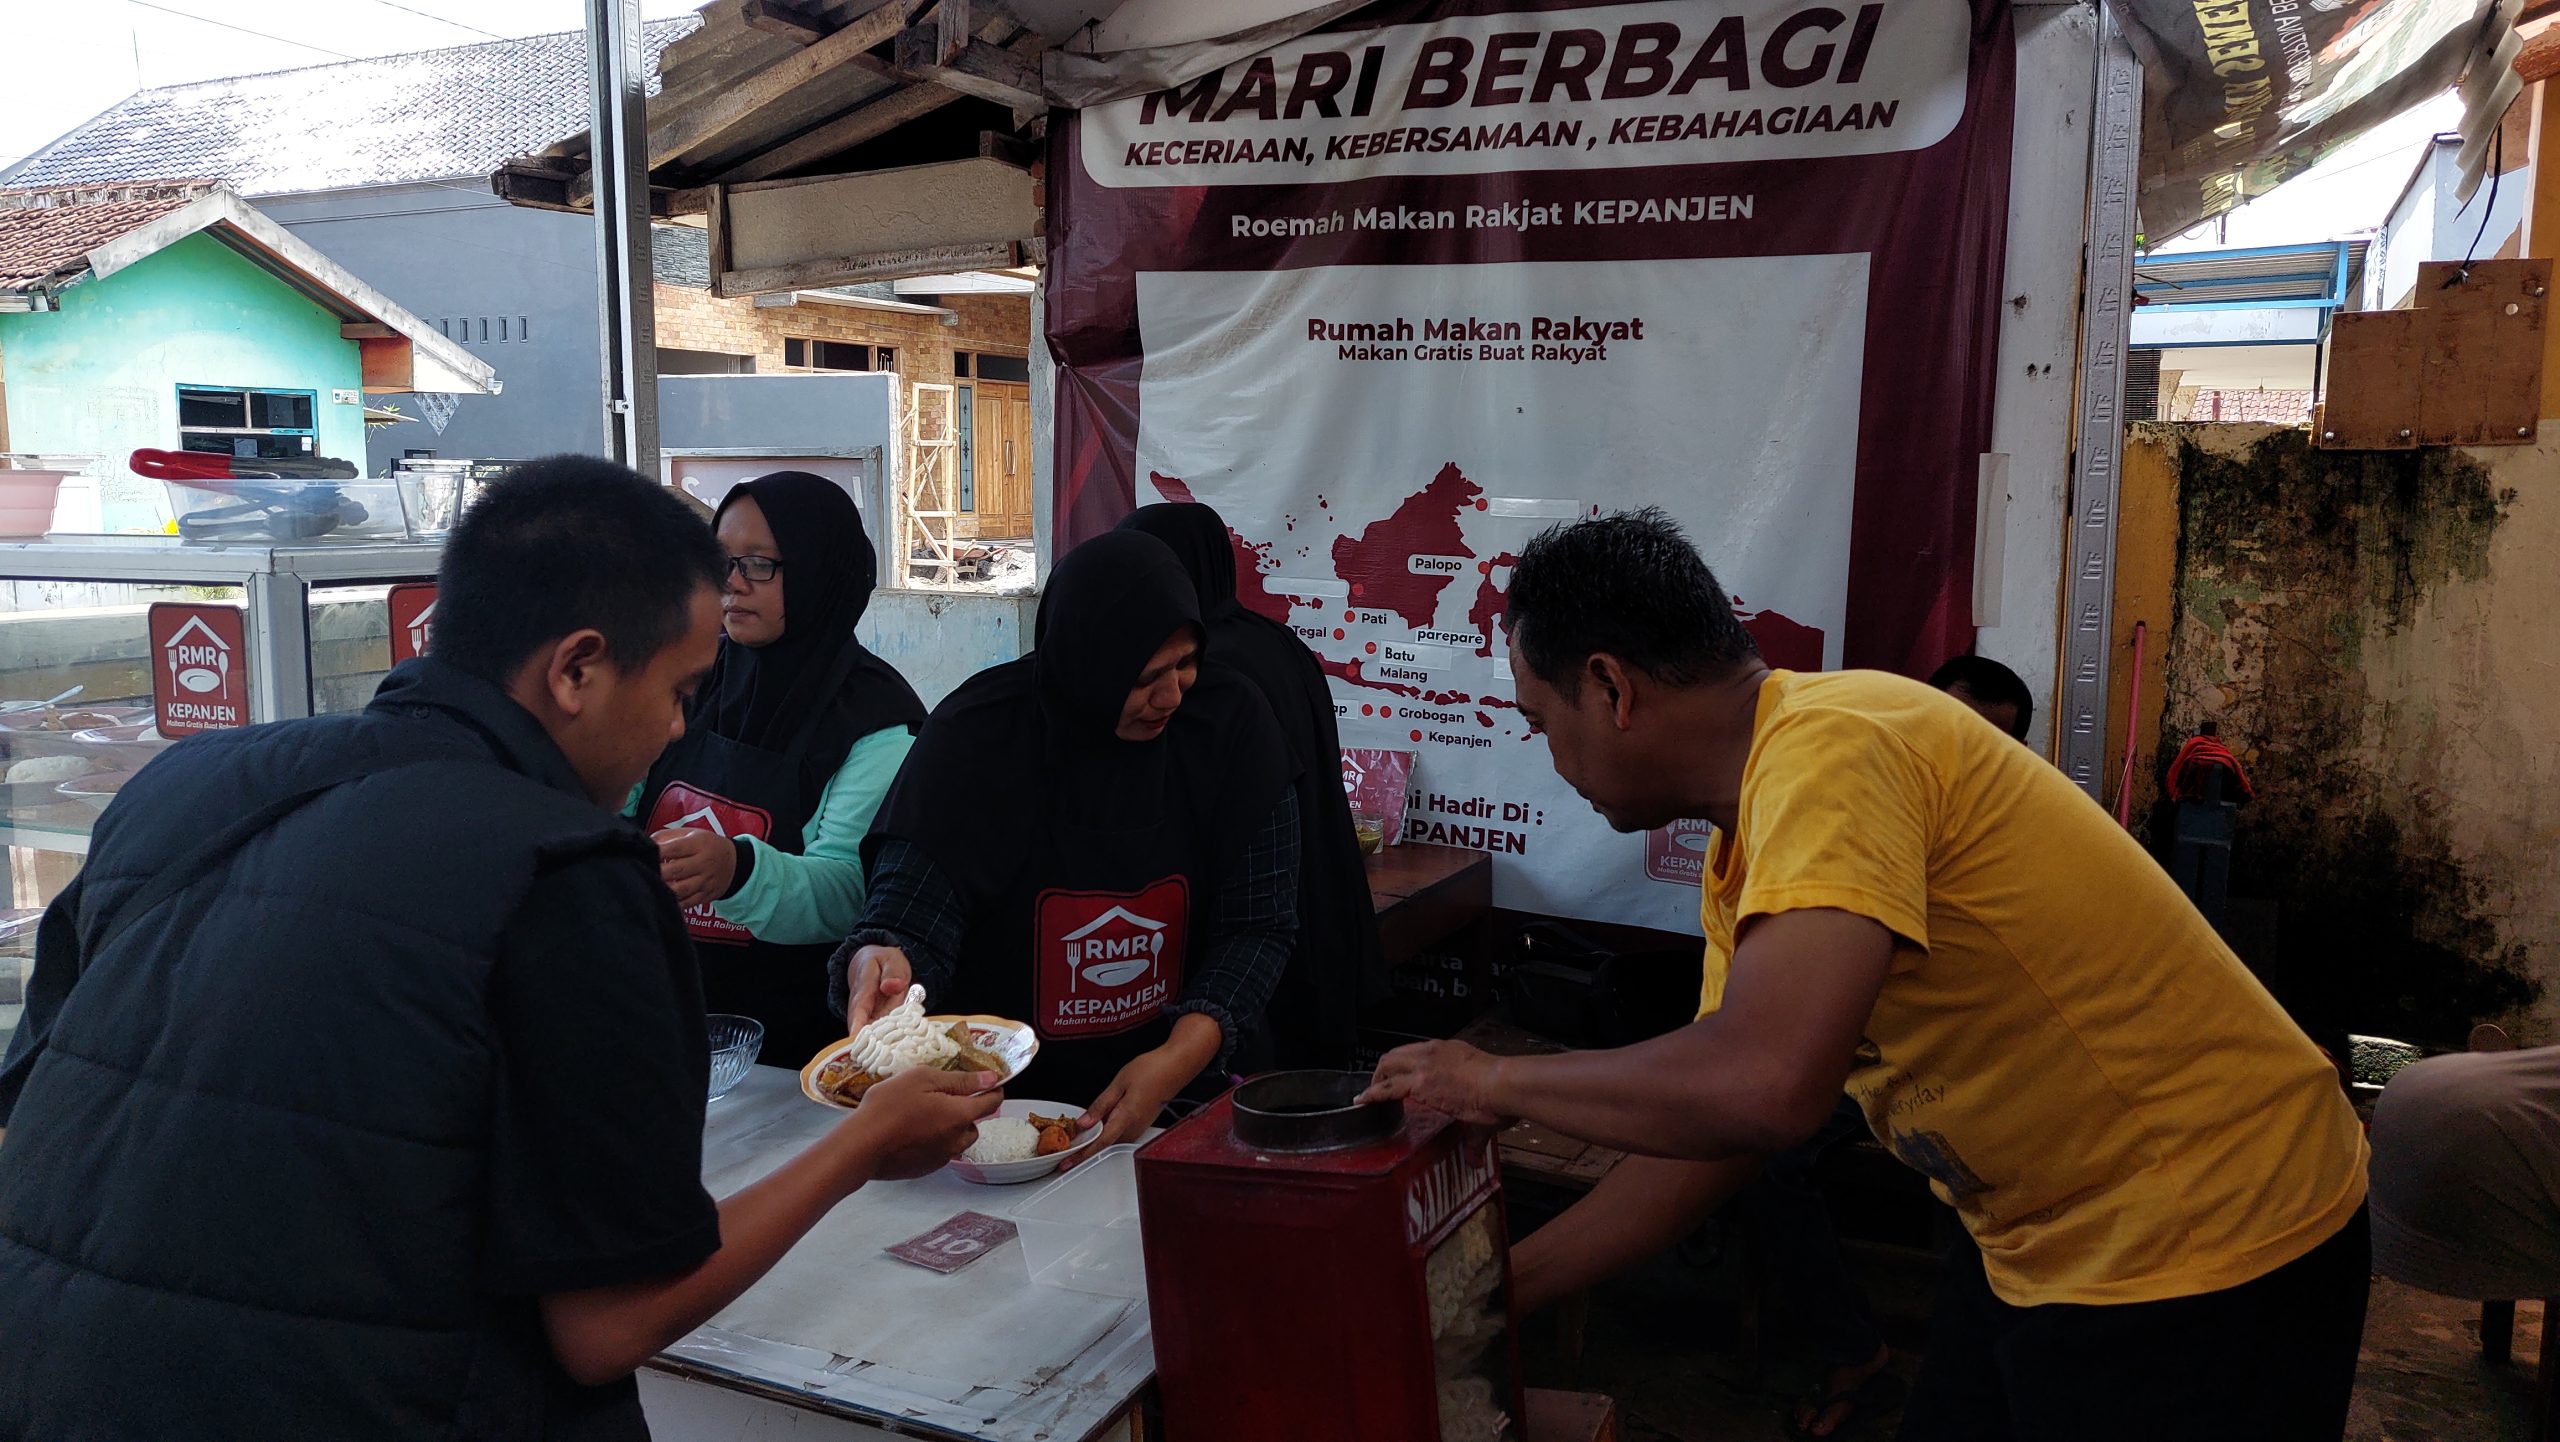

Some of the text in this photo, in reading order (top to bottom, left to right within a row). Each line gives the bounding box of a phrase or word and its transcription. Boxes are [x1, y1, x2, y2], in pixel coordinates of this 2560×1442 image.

[1139, 3, 1884, 125] MARI BERBAGI
[1125, 137, 1315, 167] KECERIAAN,
[1325, 120, 1582, 161] KEBERSAMAAN
[1607, 100, 1899, 145] KEBAHAGIAAN
[1231, 194, 1755, 238] Roemah Makan Rakjat KEPANJEN
[1308, 316, 1644, 347] Rumah Makan Rakyat
[1338, 344, 1607, 364] Makan Gratis Buat Rakyat
[1414, 557, 1463, 573] Palopo
[1361, 613, 1388, 625] Pati
[1292, 625, 1327, 639] Tegal
[1417, 630, 1483, 646] parepare
[178, 645, 218, 666] RMR
[1385, 647, 1415, 662] Batu
[1379, 666, 1428, 683] Malang
[168, 702, 236, 721] KEPANJEN
[1399, 707, 1465, 724] Grobogan
[1428, 731, 1492, 748] Kepanjen
[1343, 770, 1356, 781] MR
[1428, 793, 1496, 819] Hadir
[1502, 802, 1530, 824] Di
[1403, 818, 1527, 855] PANJEN
[1660, 855, 1705, 871] KEPAN
[690, 917, 712, 928] Buat
[1085, 934, 1149, 960] RMR
[1058, 979, 1166, 1016] KEPANJEN
[1089, 1014, 1117, 1024] Gratis
[1120, 1006, 1140, 1020] Buat
